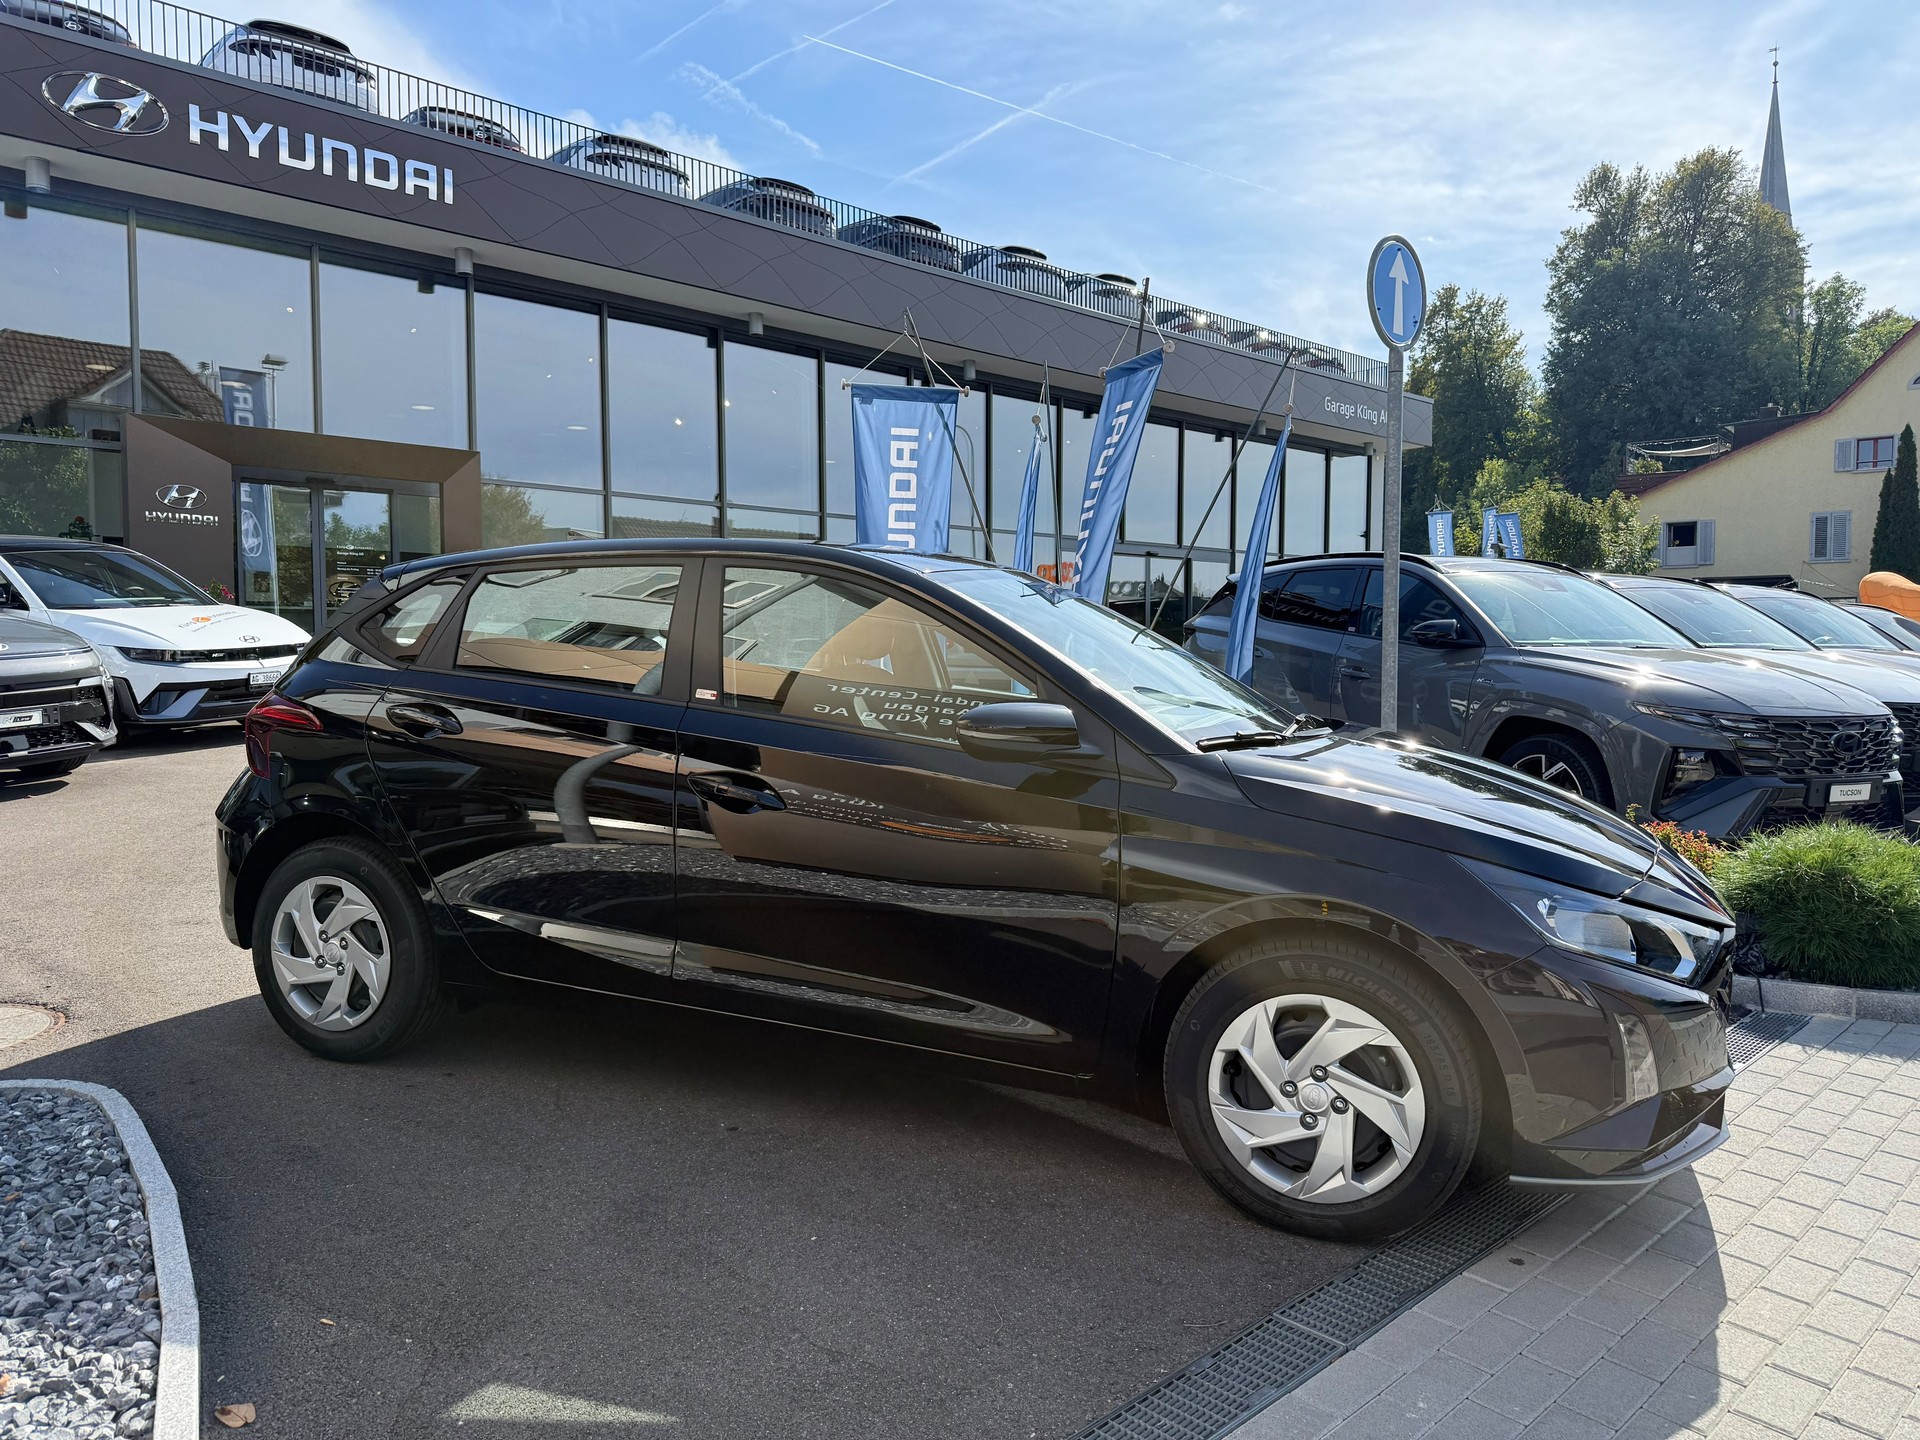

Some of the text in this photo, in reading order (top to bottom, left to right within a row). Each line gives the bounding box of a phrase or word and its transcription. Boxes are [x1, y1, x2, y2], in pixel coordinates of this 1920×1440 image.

[188, 103, 454, 205] HYUNDAI
[1324, 396, 1354, 419] Garage
[1357, 404, 1377, 425] Küng
[887, 427, 920, 549] UNDAI
[145, 510, 219, 527] HYUNDAI
[1436, 519, 1446, 555] YUNDAI
[1505, 519, 1520, 556] HYUNDAI
[1839, 788, 1862, 797] TUCSON
[1326, 966, 1422, 1022] MICHELIN
